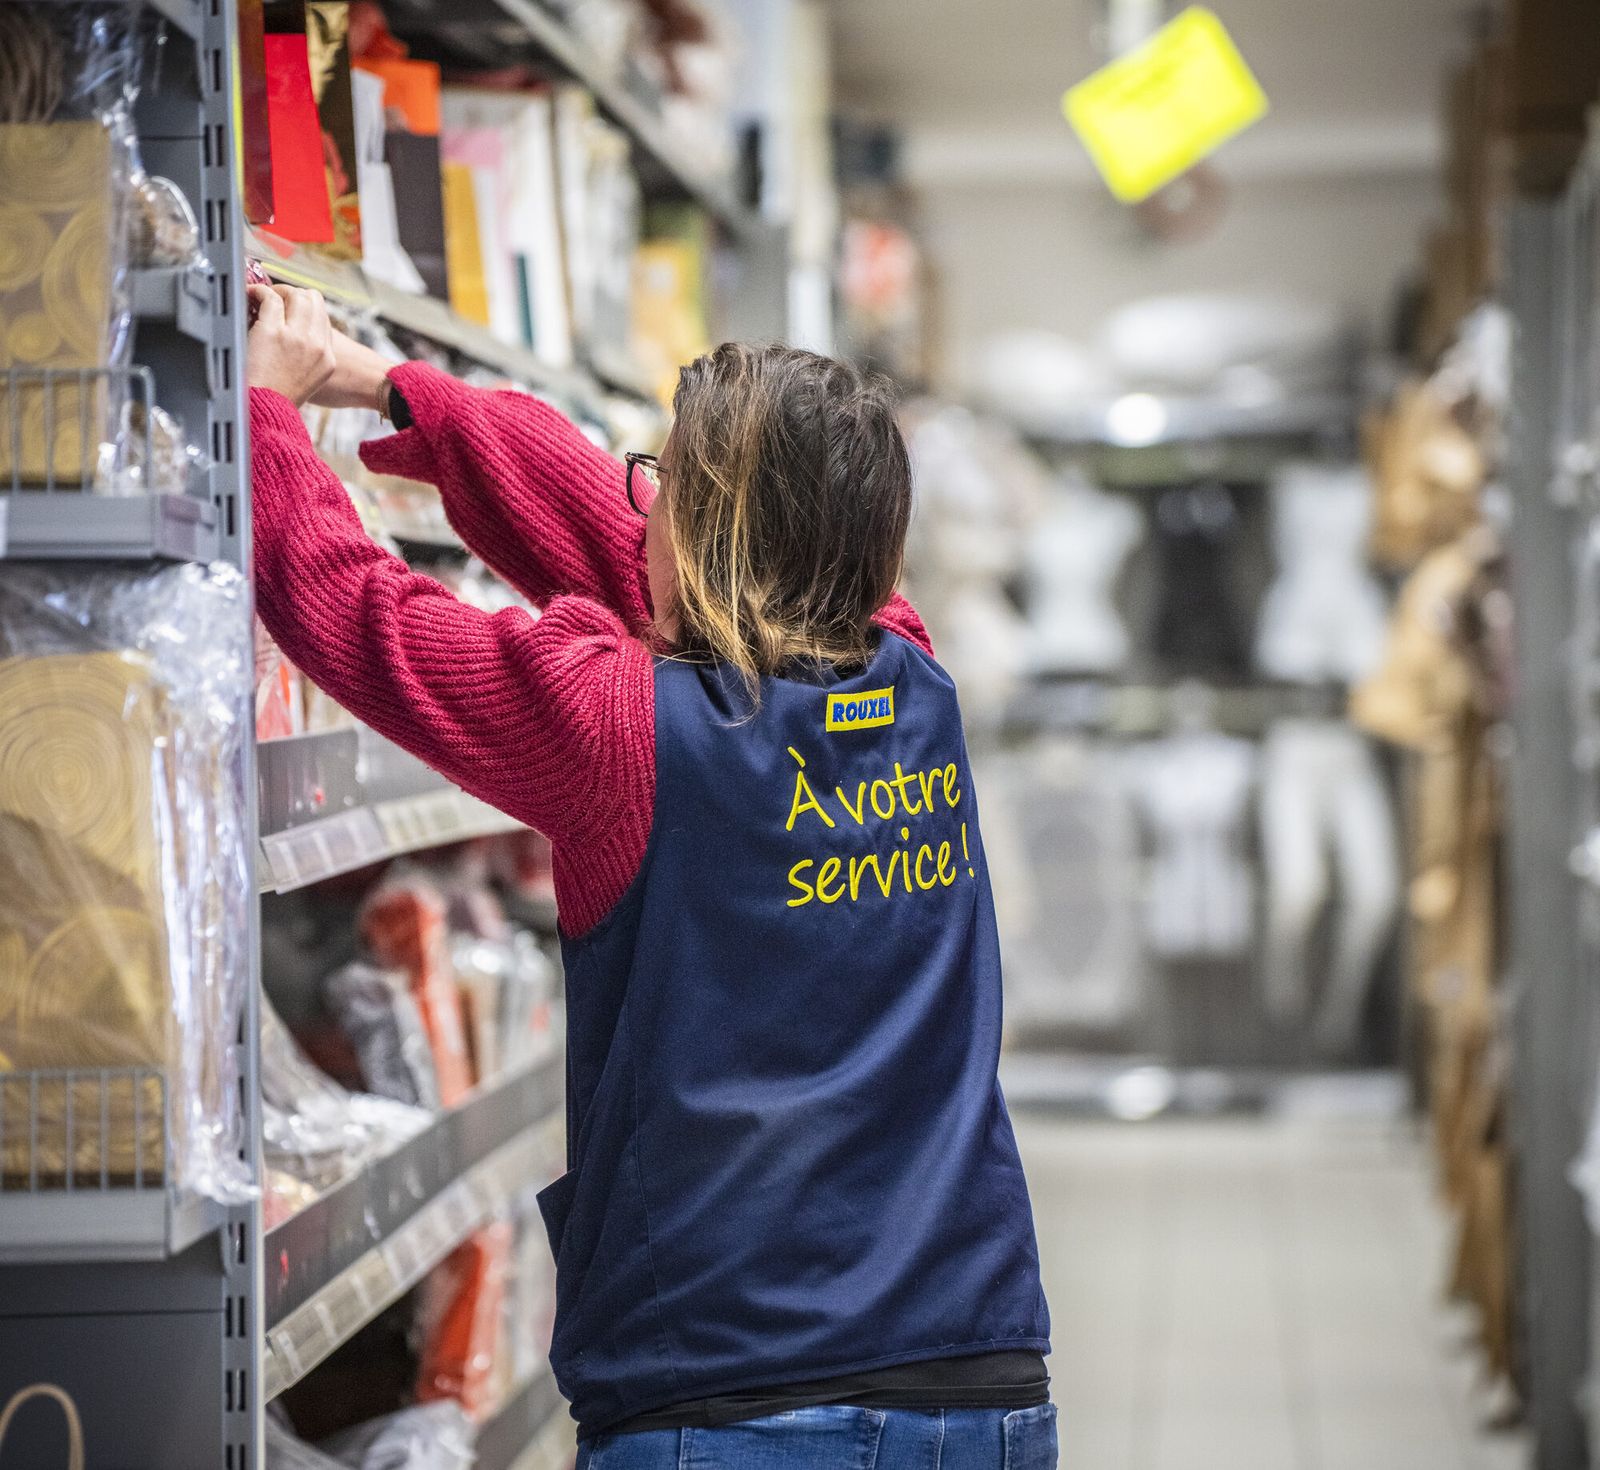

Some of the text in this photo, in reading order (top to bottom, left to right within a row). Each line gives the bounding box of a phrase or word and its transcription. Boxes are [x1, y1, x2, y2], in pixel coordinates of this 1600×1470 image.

[832, 696, 892, 723] ROUXEL
[785, 746, 961, 831] À votre
